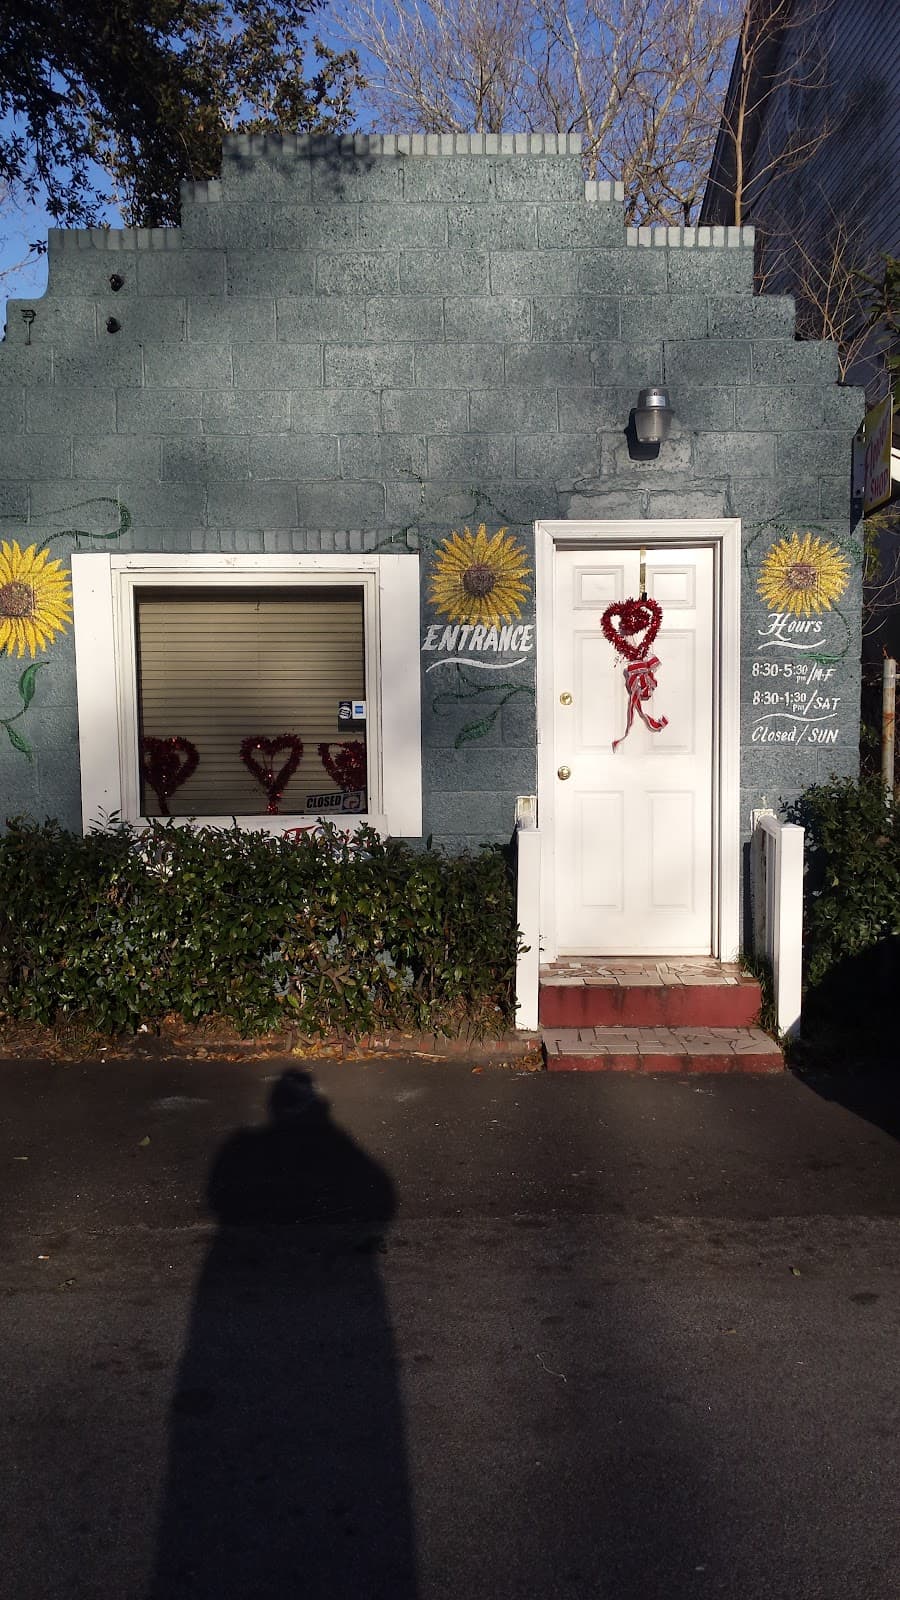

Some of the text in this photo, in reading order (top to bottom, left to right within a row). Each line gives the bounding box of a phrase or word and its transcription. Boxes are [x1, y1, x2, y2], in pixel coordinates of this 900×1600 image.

[420, 624, 535, 652] ENTRANCE
[757, 613, 823, 641] Hours
[306, 795, 342, 809] CLOSED
